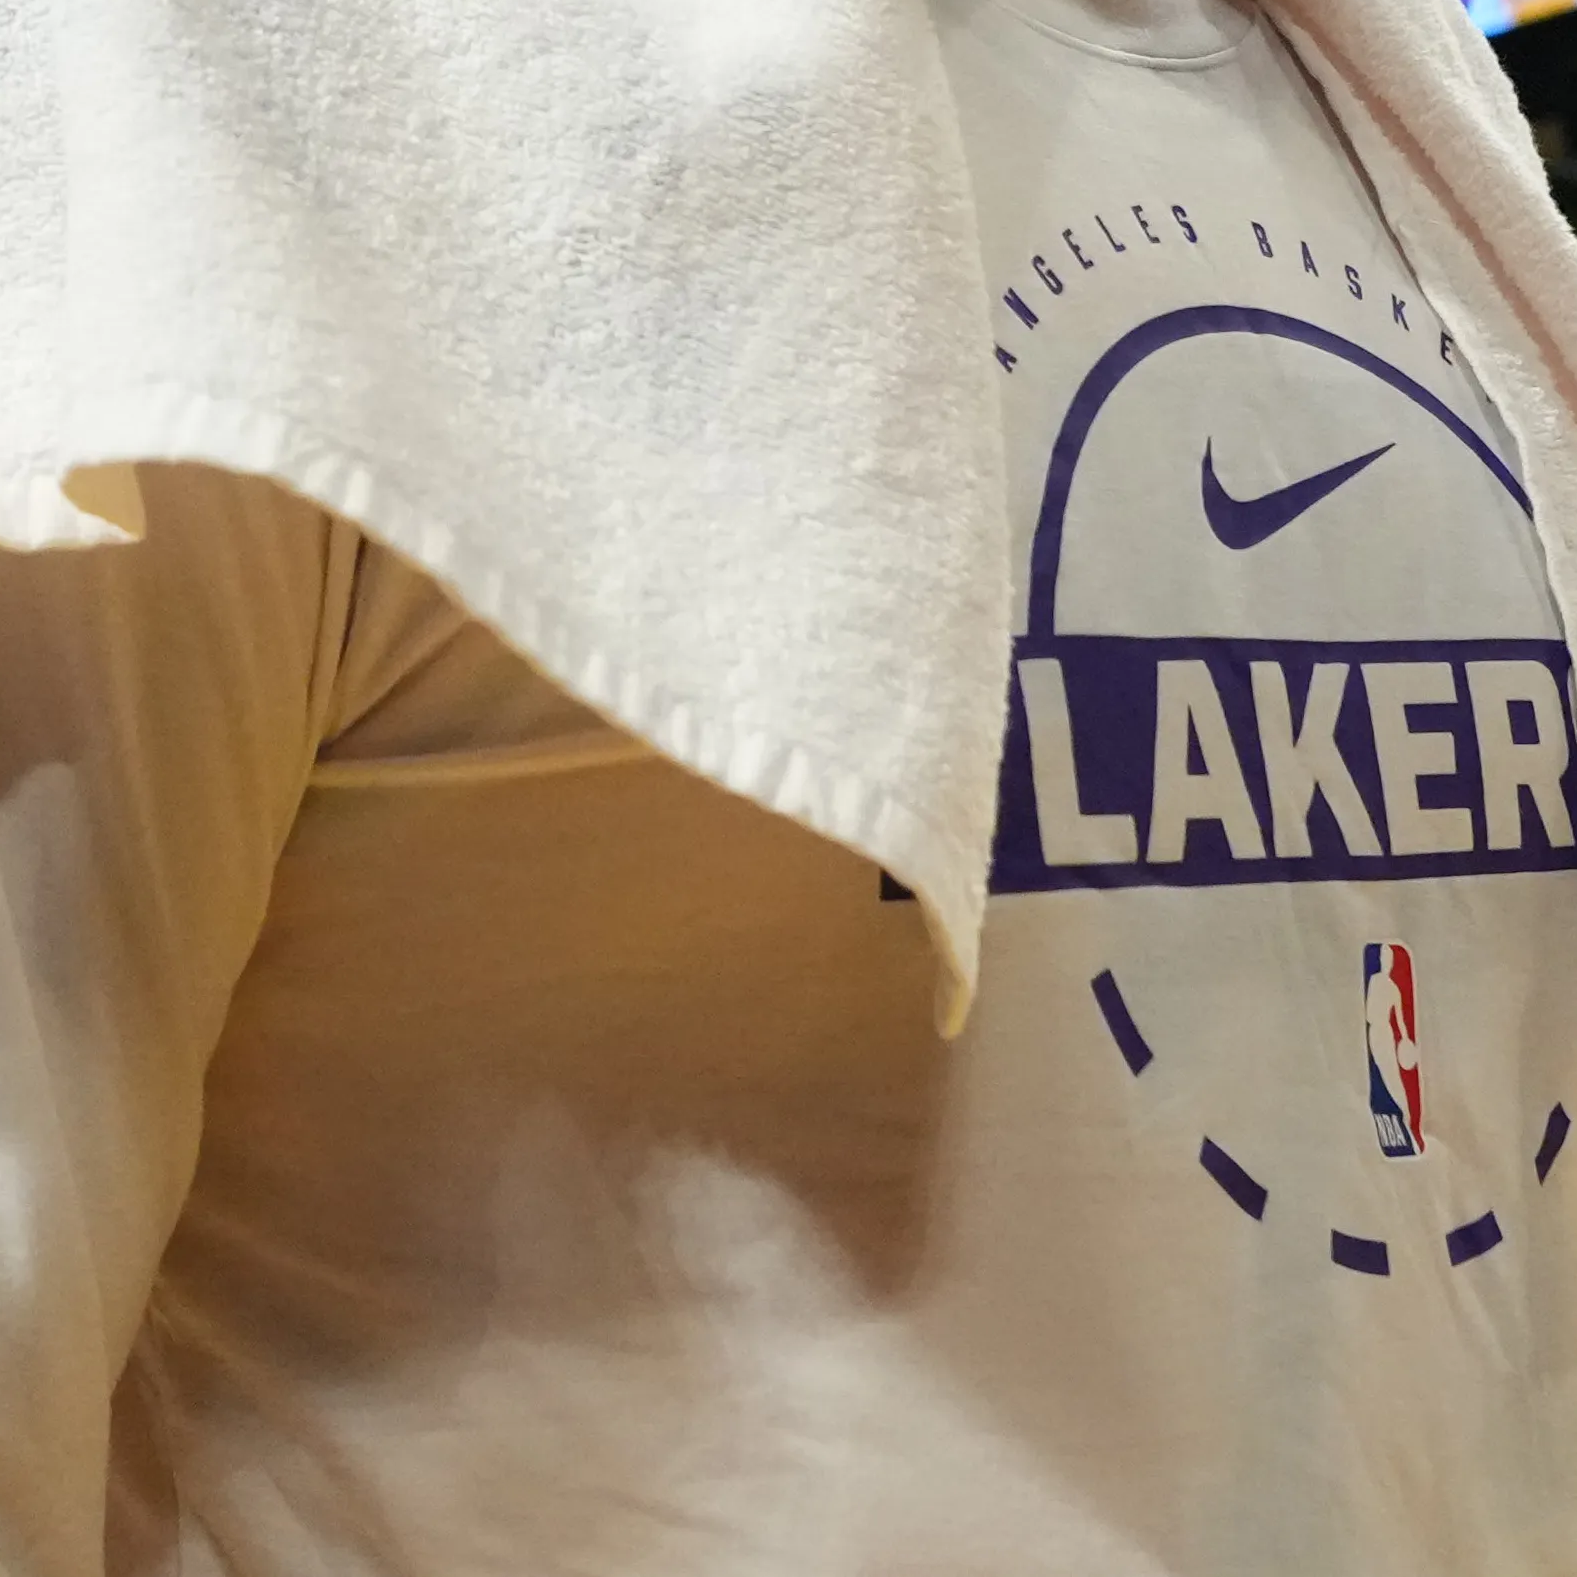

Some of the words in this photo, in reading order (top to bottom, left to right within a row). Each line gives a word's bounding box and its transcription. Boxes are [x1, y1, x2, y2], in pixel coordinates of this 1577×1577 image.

[992, 204, 1199, 374] ANGELES
[1251, 220, 1492, 403] BASKE
[1373, 1112, 1409, 1148] NBA
